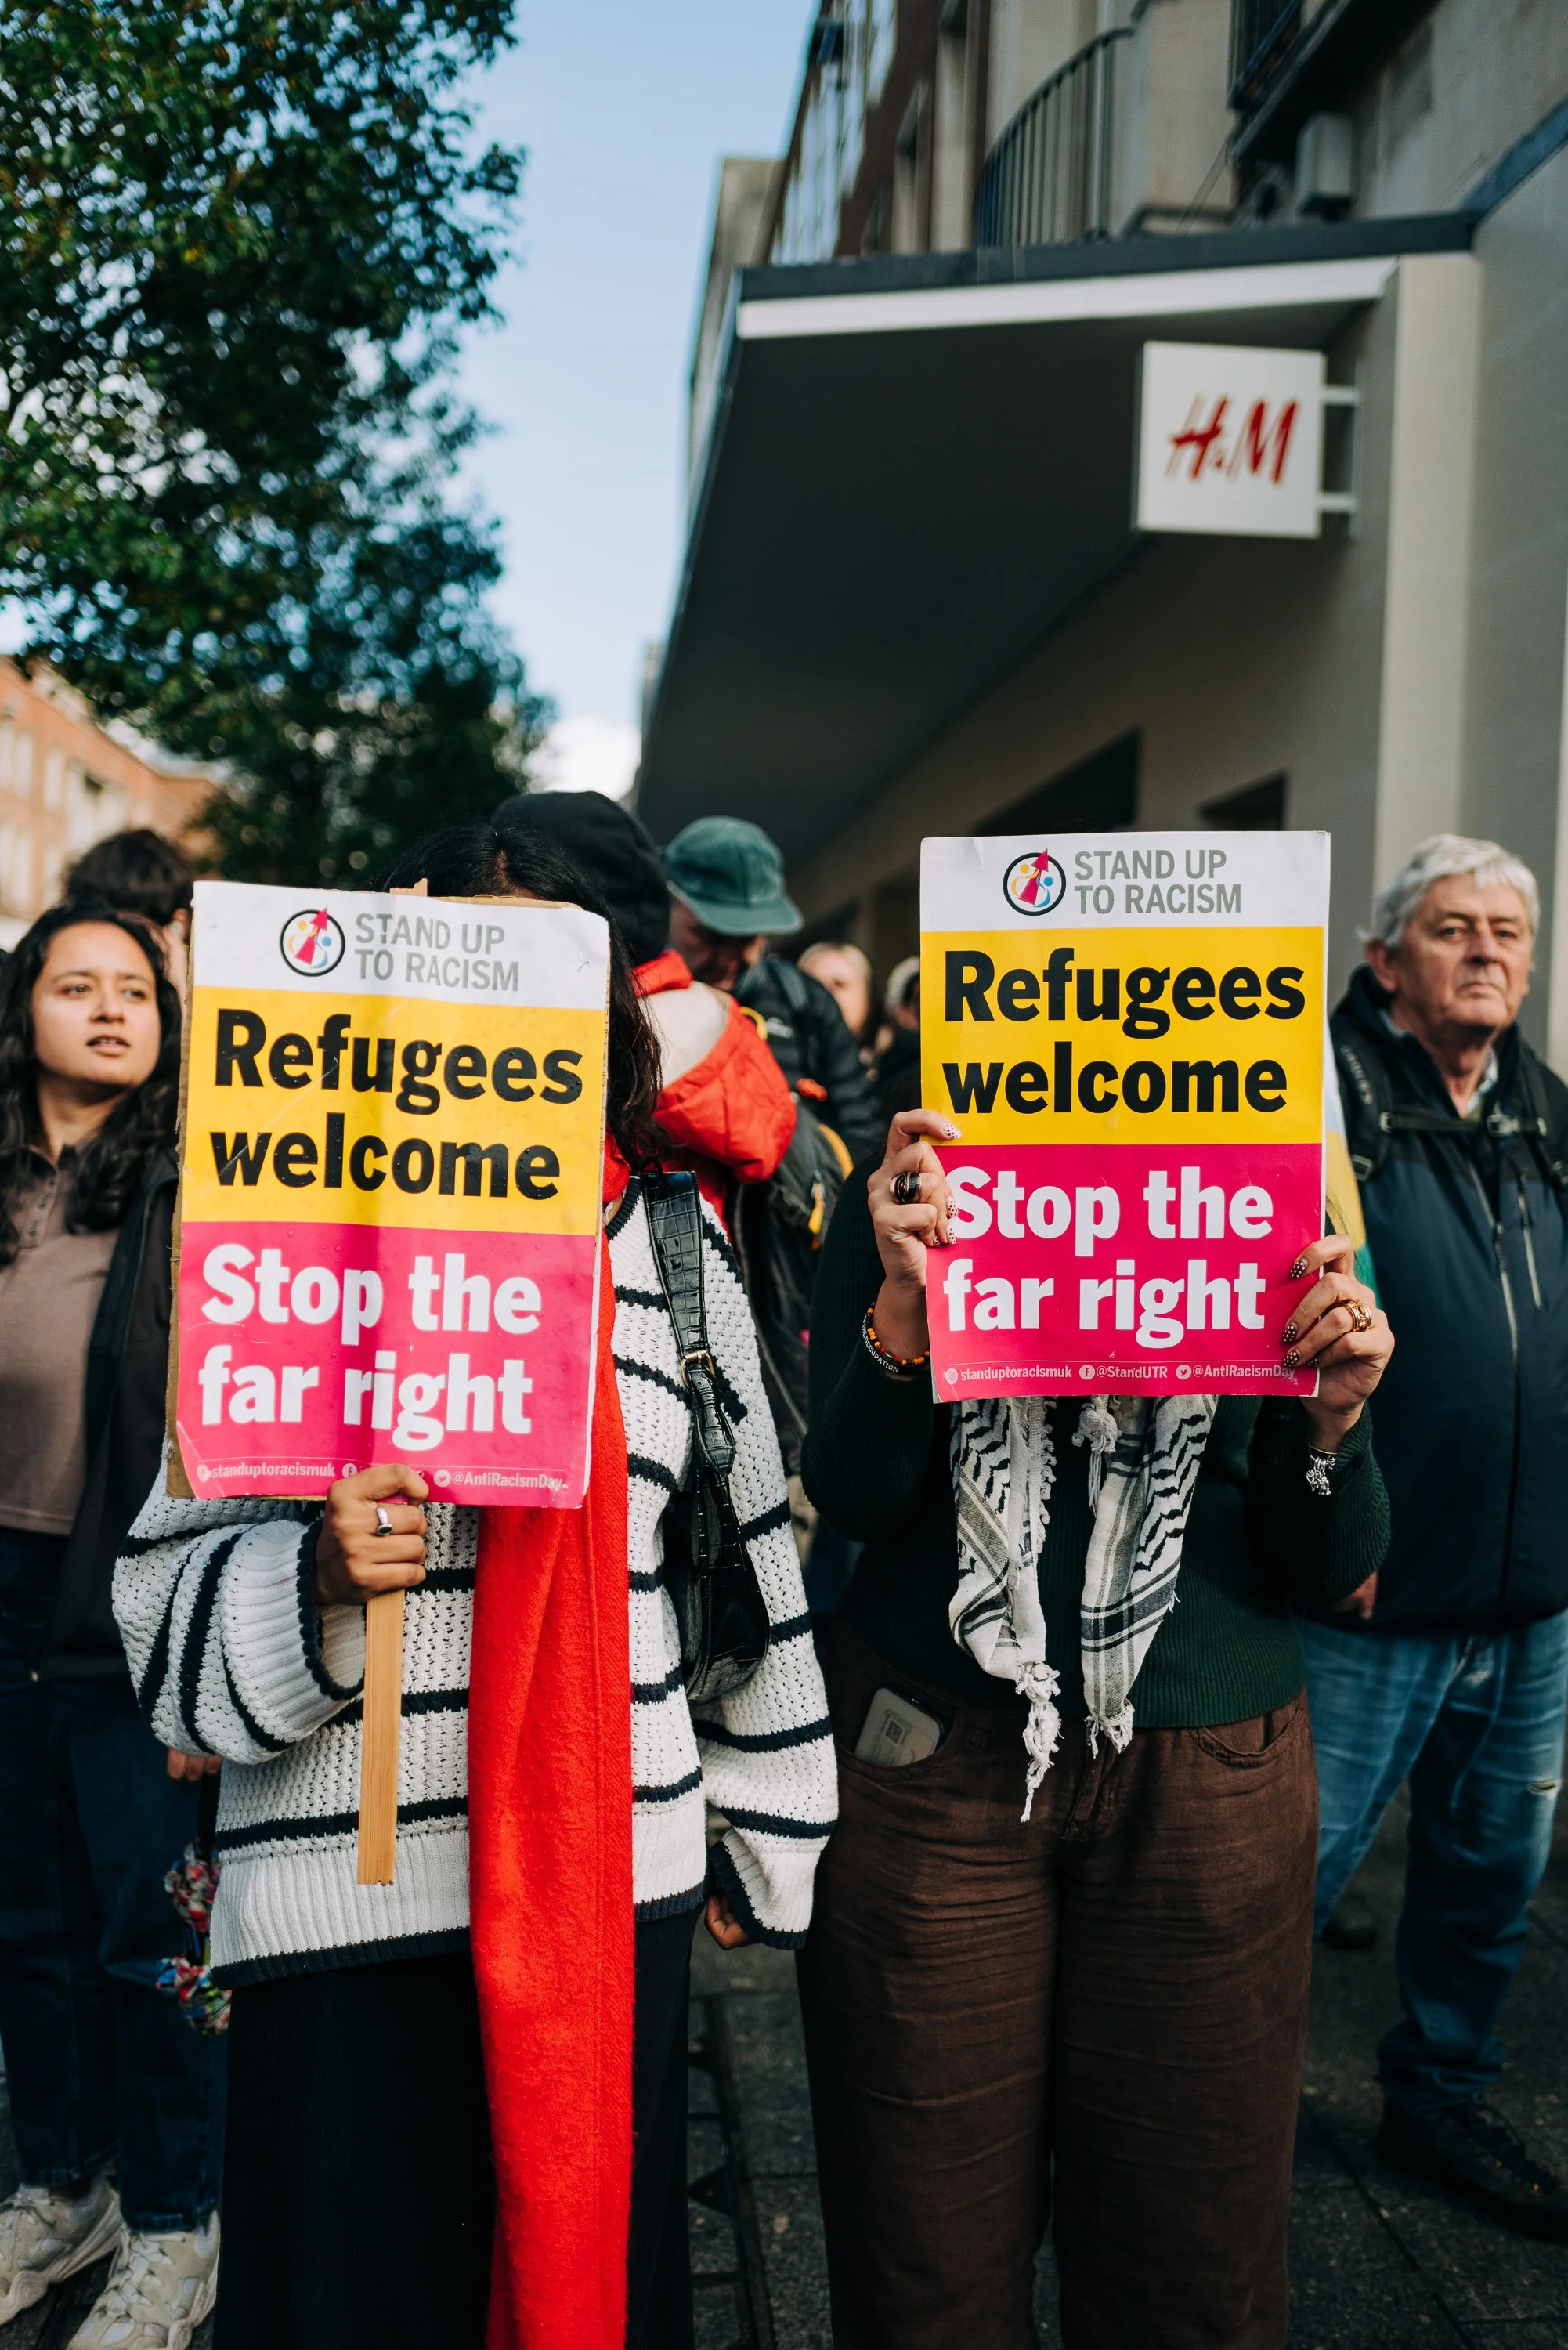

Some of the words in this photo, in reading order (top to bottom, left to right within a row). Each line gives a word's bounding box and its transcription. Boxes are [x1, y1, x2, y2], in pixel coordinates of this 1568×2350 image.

[1074, 849, 1175, 880] STAND
[1185, 849, 1227, 879] UP
[1074, 884, 1115, 915] TO
[1125, 883, 1241, 914] RACISM
[354, 948, 393, 981] TO
[405, 956, 519, 992] RACISM
[355, 913, 451, 950] STAND
[461, 924, 505, 955] UP
[945, 947, 1306, 1039] Refugees
[215, 1007, 583, 1115] Refugees
[941, 1041, 1287, 1115] welcome
[210, 1112, 560, 1201] welcome
[945, 1166, 1120, 1257] Stop
[1143, 1166, 1274, 1239] the
[201, 1244, 384, 1346] Stop
[408, 1253, 542, 1335] the
[943, 1258, 1054, 1332] far
[1079, 1259, 1266, 1349] right
[198, 1344, 319, 1426] far
[343, 1350, 533, 1451] right
[961, 1365, 1072, 1381] standuptoracismuk
[1097, 1365, 1168, 1379] @StandUTR
[1193, 1365, 1295, 1380] @AntiRacismDay
[211, 1462, 335, 1478] standuptoracismuk
[452, 1471, 562, 1490] @AntiRacismDay
